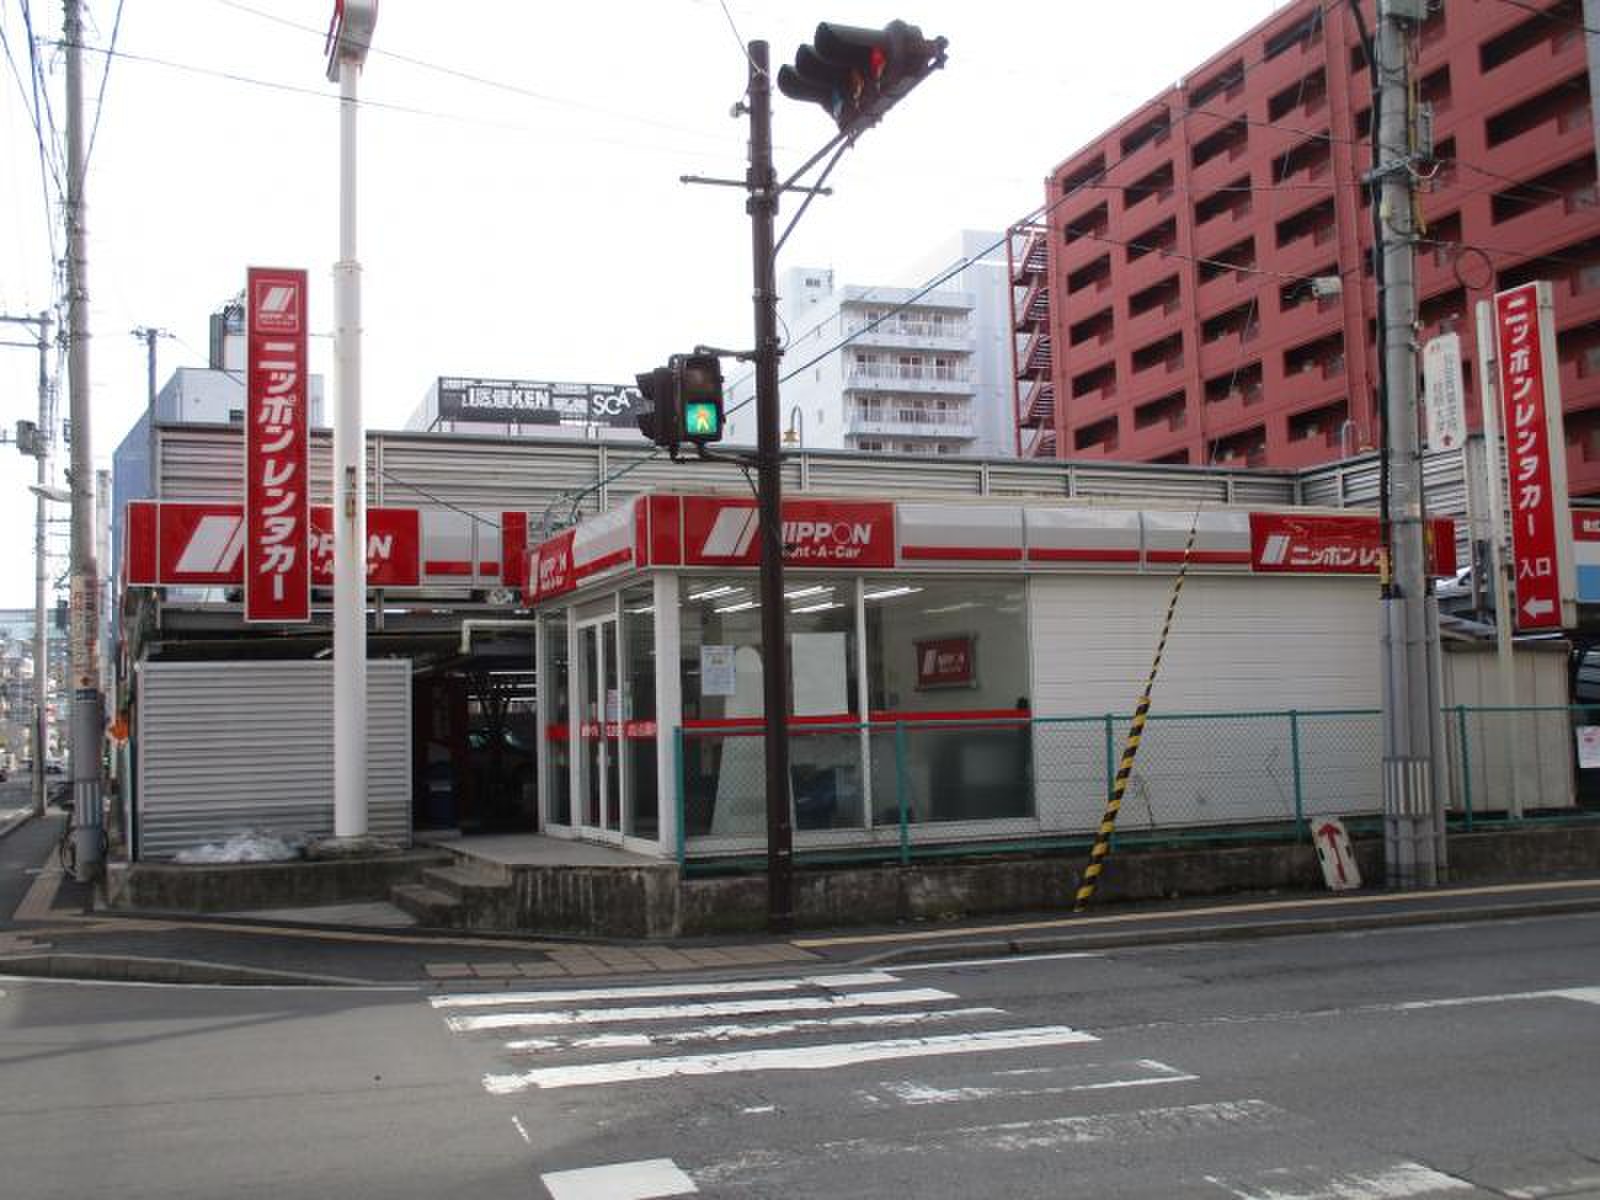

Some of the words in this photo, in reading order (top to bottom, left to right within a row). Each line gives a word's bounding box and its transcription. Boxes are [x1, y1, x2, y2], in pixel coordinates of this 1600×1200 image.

[258, 341, 297, 601] ニッポンレンタカー
[1504, 297, 1541, 537] ニッポンレンタカー
[1290, 544, 1379, 567] ニッポンレ
[1519, 556, 1551, 580] 入口
